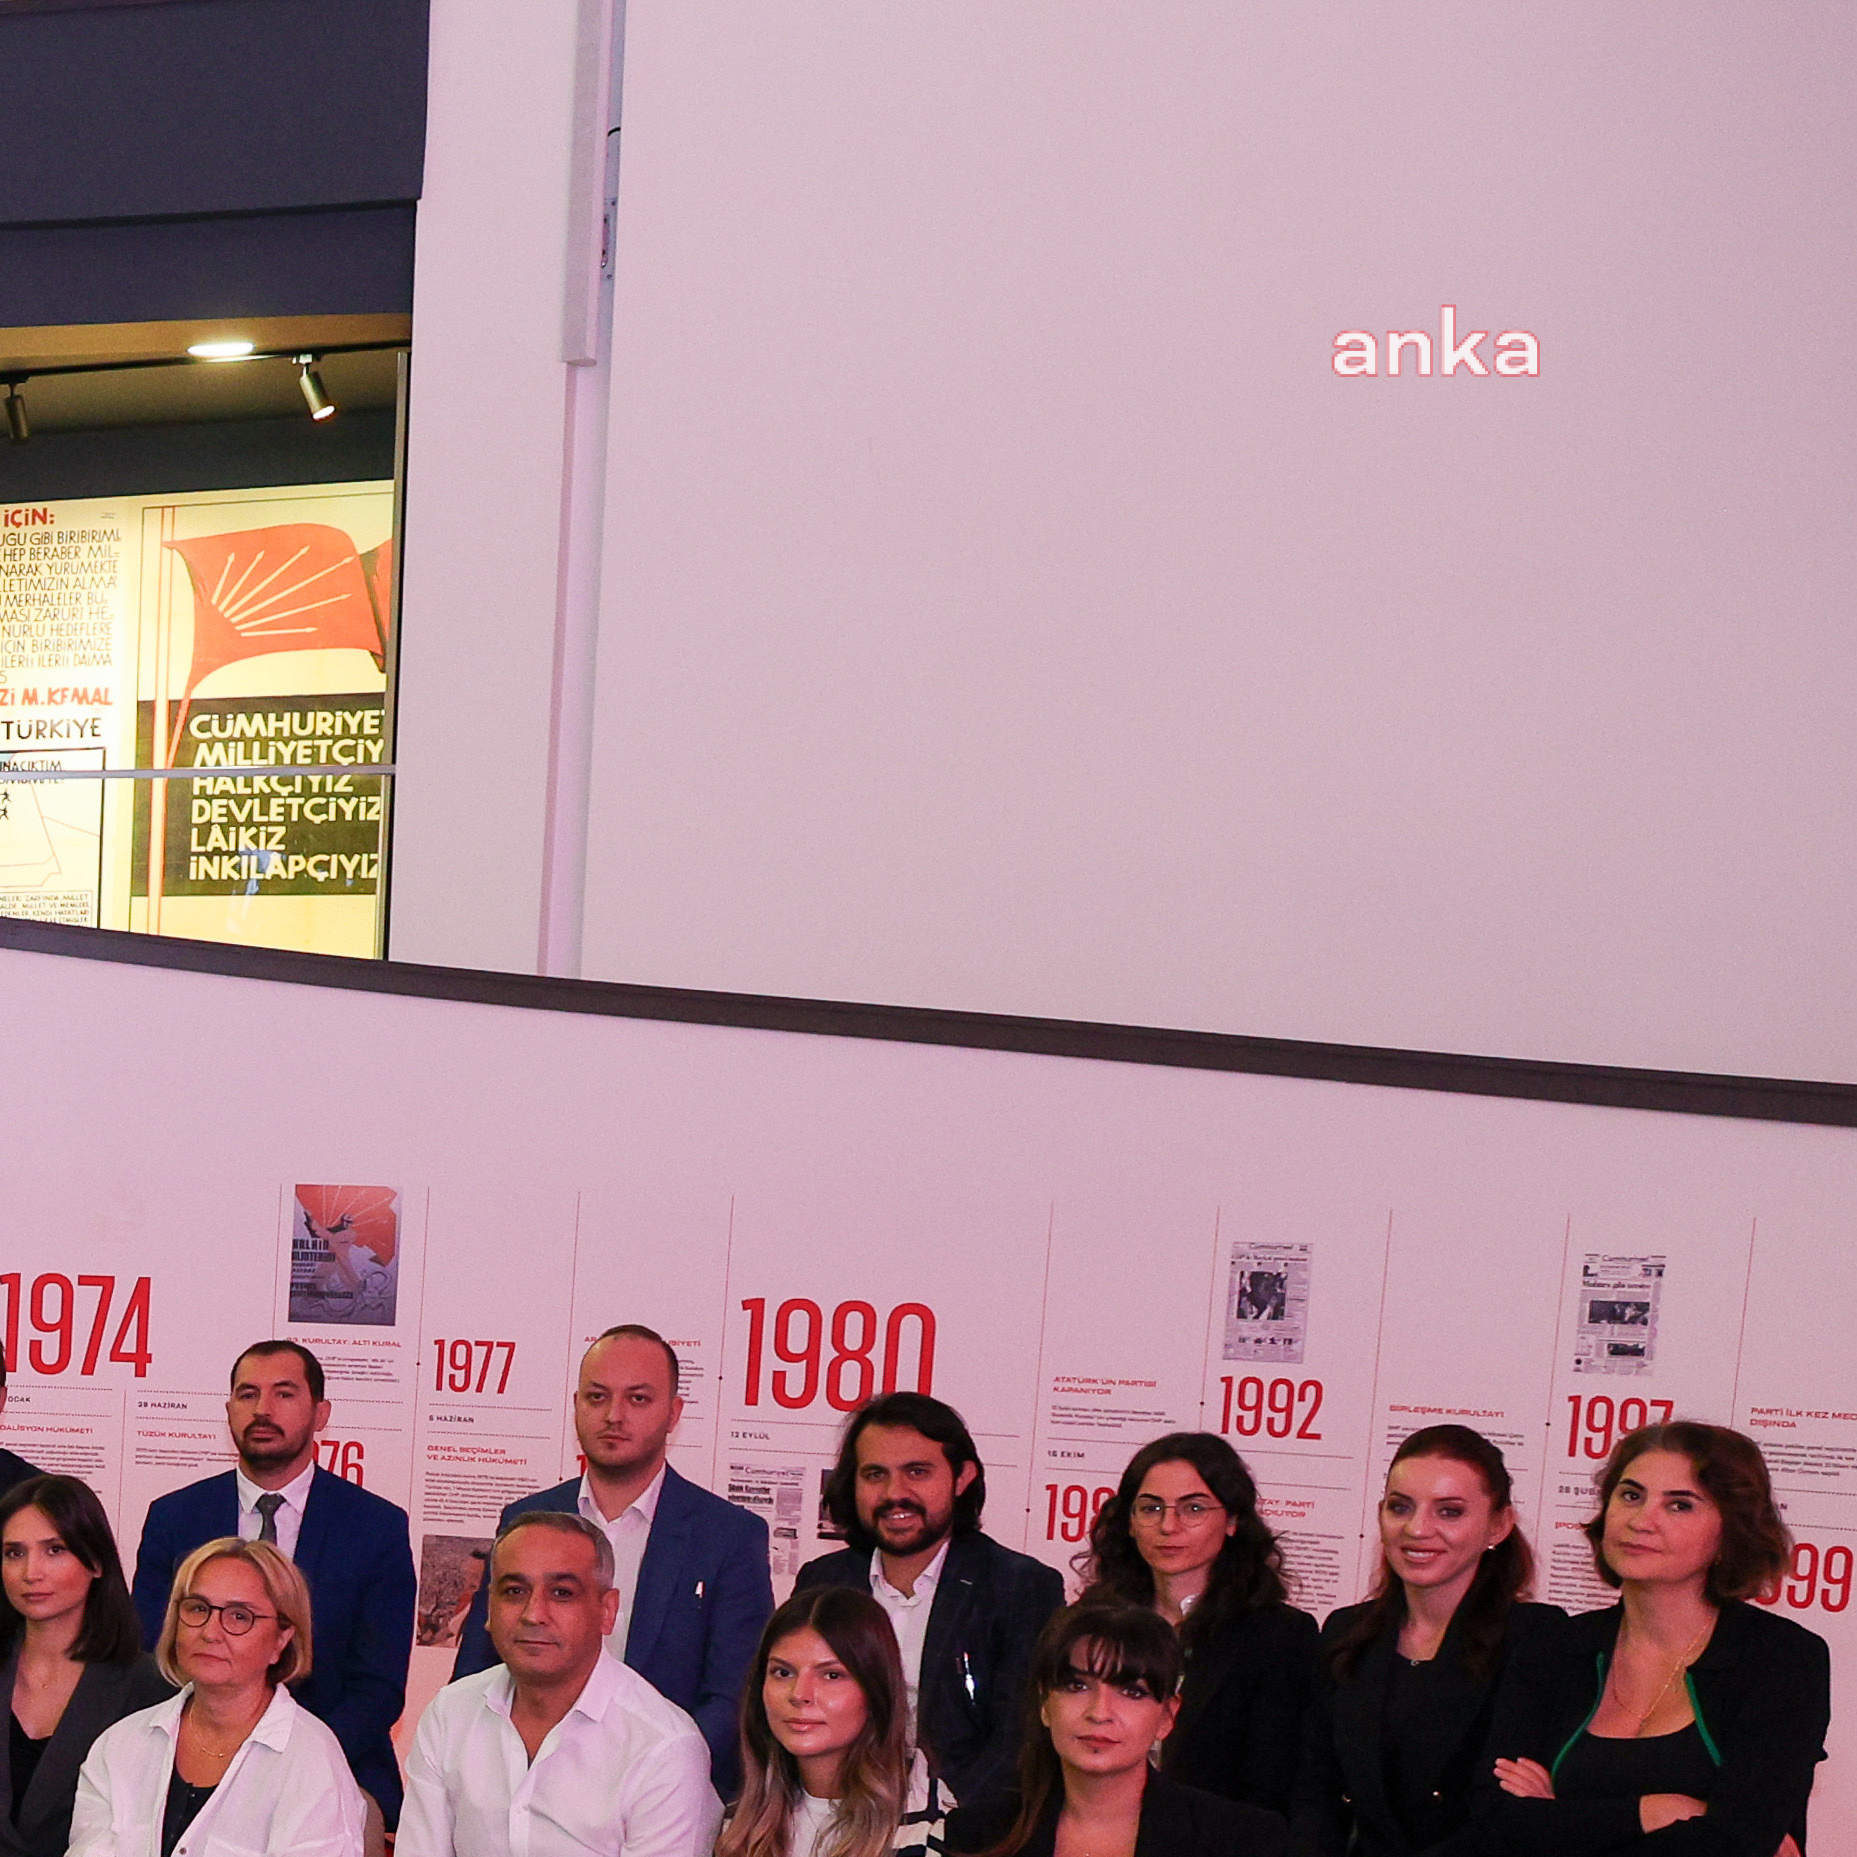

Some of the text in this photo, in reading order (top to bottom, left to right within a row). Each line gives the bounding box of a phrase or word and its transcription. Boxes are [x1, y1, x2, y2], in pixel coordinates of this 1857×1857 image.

[3, 507, 55, 528] İÇİN:
[3, 547, 26, 562] HEP
[29, 545, 82, 561] BERABER
[4, 591, 82, 608] MERHALELER
[50, 621, 113, 637] HEDEFLERE
[1, 717, 102, 741] TÜRKİYE
[189, 709, 385, 739] CÜMHURİYE
[190, 795, 382, 825] DEVLETÇİYİZ
[0, 1272, 152, 1378] 1974
[433, 1339, 516, 1394] 1977
[741, 1297, 936, 1412] 1980
[1220, 1376, 1324, 1441] 1992
